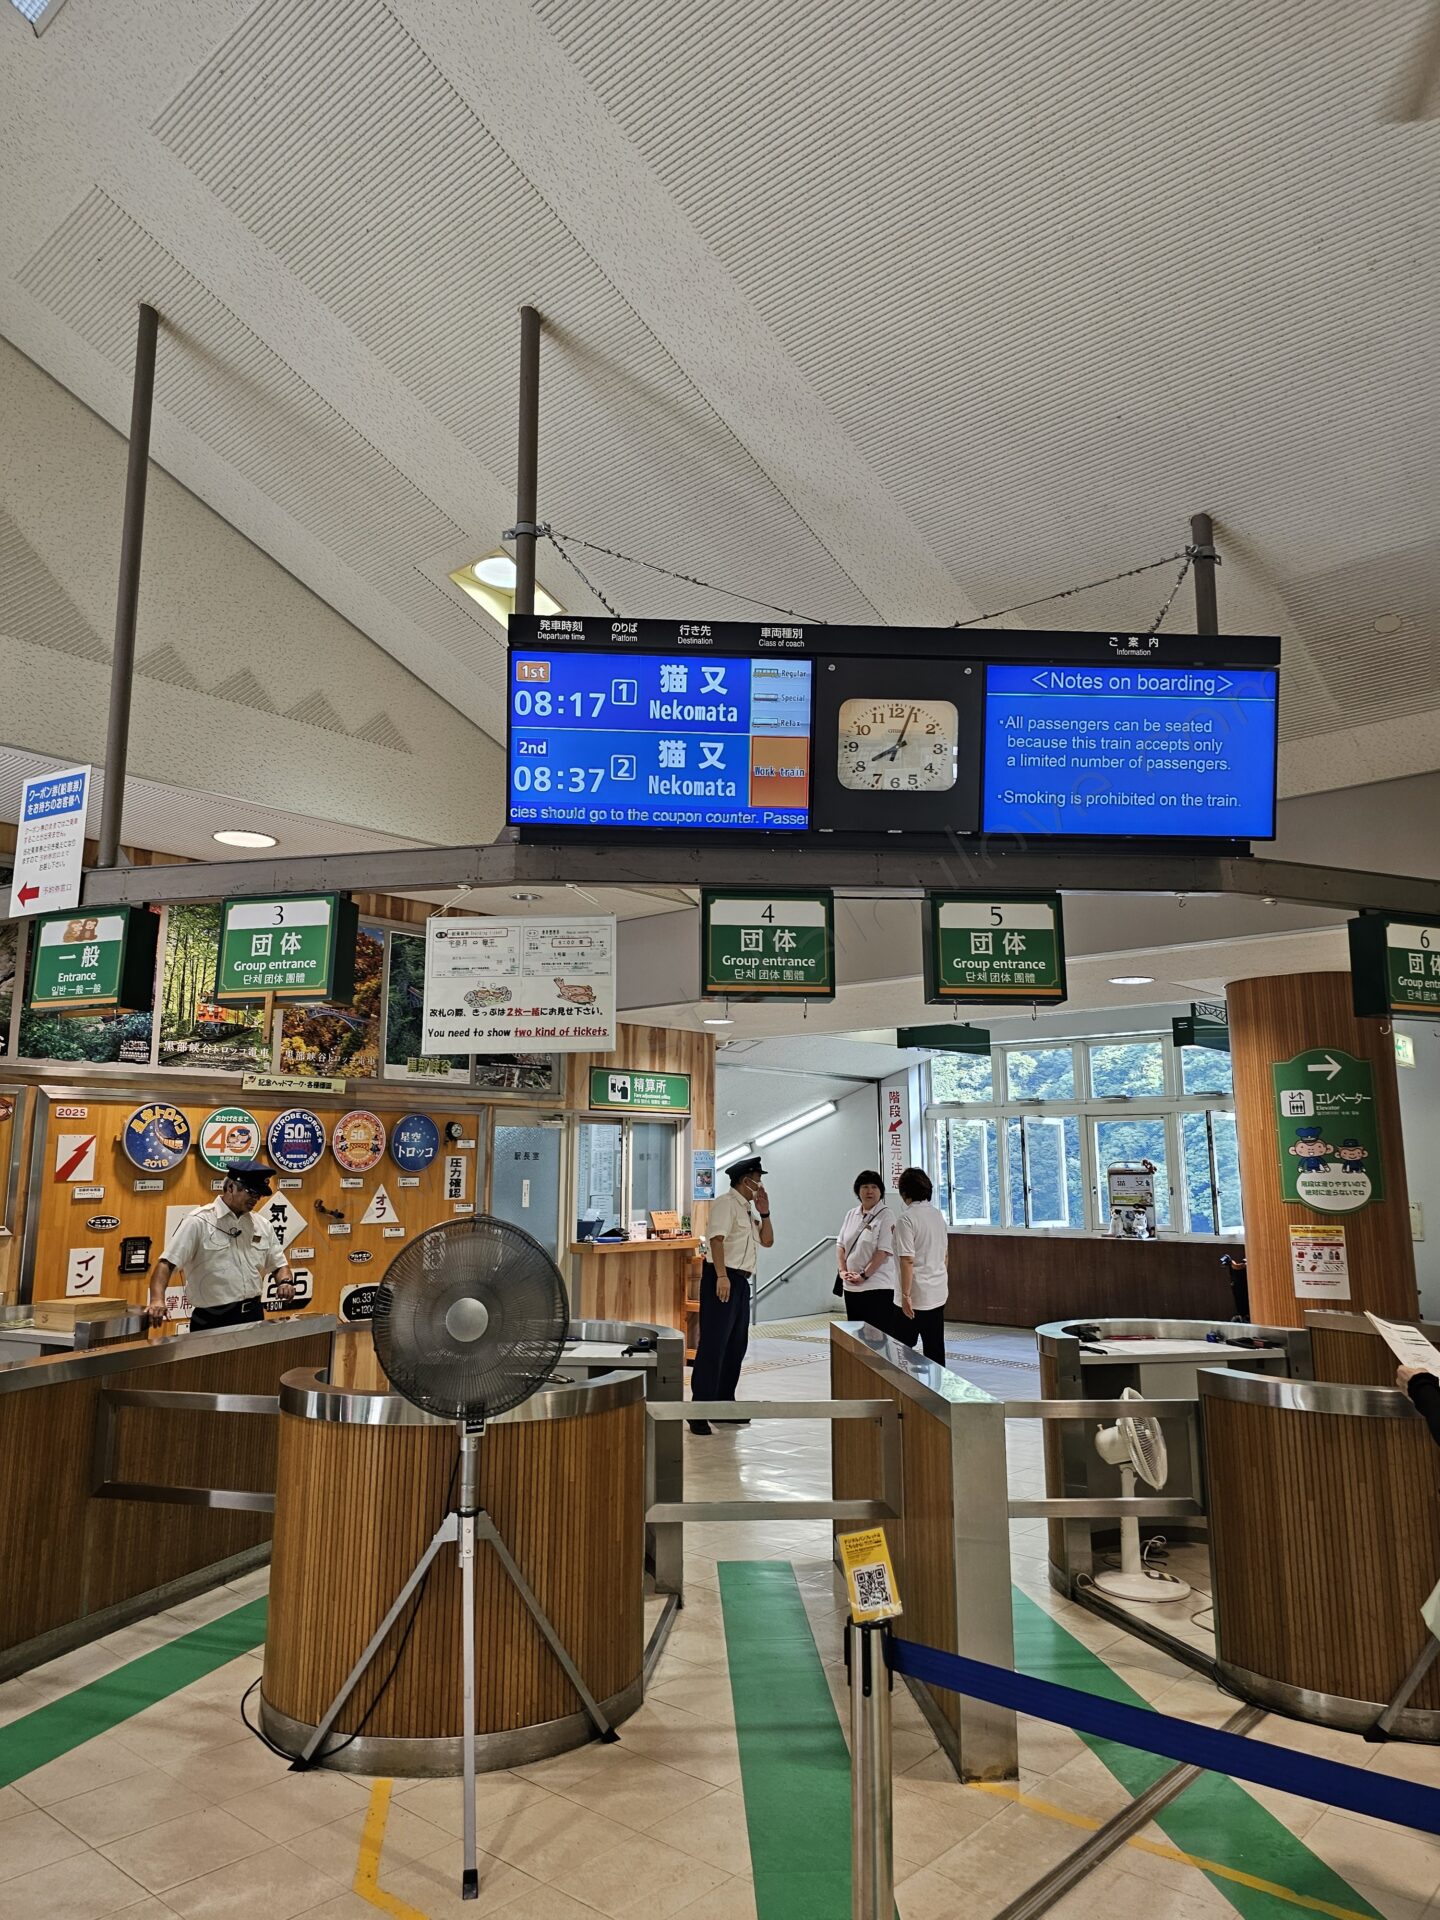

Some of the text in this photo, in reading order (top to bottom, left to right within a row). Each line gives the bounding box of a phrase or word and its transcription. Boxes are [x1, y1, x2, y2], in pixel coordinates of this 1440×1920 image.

[540, 620, 582, 632] 発車時刻
[612, 622, 638, 633] のりば
[680, 624, 712, 636] 行き先
[538, 631, 586, 640] Departure time
[612, 634, 638, 642] Platform
[761, 628, 803, 640] 車両種別
[678, 636, 713, 645] Destination
[758, 639, 776, 647] Class
[785, 640, 804, 648] coach
[1108, 636, 1159, 648] ご案内
[1116, 648, 1152, 656] Information
[522, 665, 545, 678] 1st
[781, 670, 806, 678] Regular
[660, 664, 728, 695] 猫又
[1108, 677, 1131, 690] on
[618, 683, 628, 702] 1
[781, 694, 806, 702] Special
[514, 690, 606, 718] 08:17
[650, 700, 738, 722] Nekomata
[889, 708, 904, 718] 12
[913, 712, 918, 722] 1
[780, 719, 800, 727] Relax
[872, 713, 885, 724] 11
[856, 724, 871, 736] 10
[926, 724, 936, 734] 2
[1028, 718, 1110, 734] passengers
[1113, 720, 1139, 732] can
[1143, 718, 1161, 732] be
[1164, 720, 1212, 733] seated
[519, 741, 547, 754] 2nd
[848, 742, 858, 752] 9
[933, 744, 944, 754] 3
[1008, 735, 1223, 754] because this train accepts only
[658, 740, 726, 770] 猫又
[617, 758, 630, 777] 2
[856, 761, 866, 772] 8
[924, 763, 934, 774] 4
[1006, 754, 1232, 773] a limited number of passengers.
[754, 766, 805, 777] Work train
[514, 766, 605, 793] 08:37
[872, 774, 882, 784] 7
[890, 778, 900, 788] 6
[908, 774, 918, 785] 5
[648, 774, 736, 797] Nekomata
[28, 795, 81, 816] をお持ちのお客様へ
[1070, 792, 1082, 805] is
[1086, 792, 1155, 808] prohibited
[1158, 795, 1177, 806] on
[1180, 794, 1203, 806] the
[1206, 794, 1242, 808] train.
[541, 806, 586, 819] should
[590, 810, 608, 822] go
[610, 808, 624, 820] to
[628, 808, 648, 820] the
[652, 812, 702, 824] coupon
[706, 812, 760, 824] counter.
[272, 905, 284, 926] 3
[760, 904, 775, 924] 4
[990, 906, 1003, 926] 5
[251, 932, 302, 956] 団体
[740, 928, 796, 952] 団体
[970, 932, 1026, 956] 団体
[1420, 930, 1430, 948] 6
[58, 945, 100, 968] 一般
[722, 955, 816, 968] Group entrance
[234, 959, 316, 973] Group entrance
[952, 958, 1046, 971] Group entrance
[58, 972, 96, 982] Entrance
[734, 968, 756, 980] 단체
[966, 972, 988, 982] 단체
[1398, 976, 1423, 988] Group
[428, 1029, 444, 1038] You
[448, 1028, 470, 1037] need
[474, 1028, 484, 1036] to
[488, 1028, 511, 1036] show
[514, 1028, 532, 1036] two
[560, 1027, 570, 1036] of
[574, 1026, 610, 1036] tickets.
[634, 1076, 667, 1094] 精算所
[888, 1090, 901, 1118] 階段
[1316, 1093, 1372, 1104] エレベーター
[58, 1108, 86, 1117] 2025
[274, 1112, 322, 1137] KUROBE GORGE
[284, 1124, 312, 1138] 50th
[400, 1132, 422, 1142] 星空
[206, 1126, 252, 1153] 40
[398, 1146, 434, 1158] トロッコ
[514, 1152, 540, 1160] 駅長室
[449, 1158, 462, 1198] 圧力確認
[1301, 1180, 1366, 1188] 階段は滑りやすいので
[376, 1194, 387, 1218] オフ
[74, 1255, 96, 1290] イン
